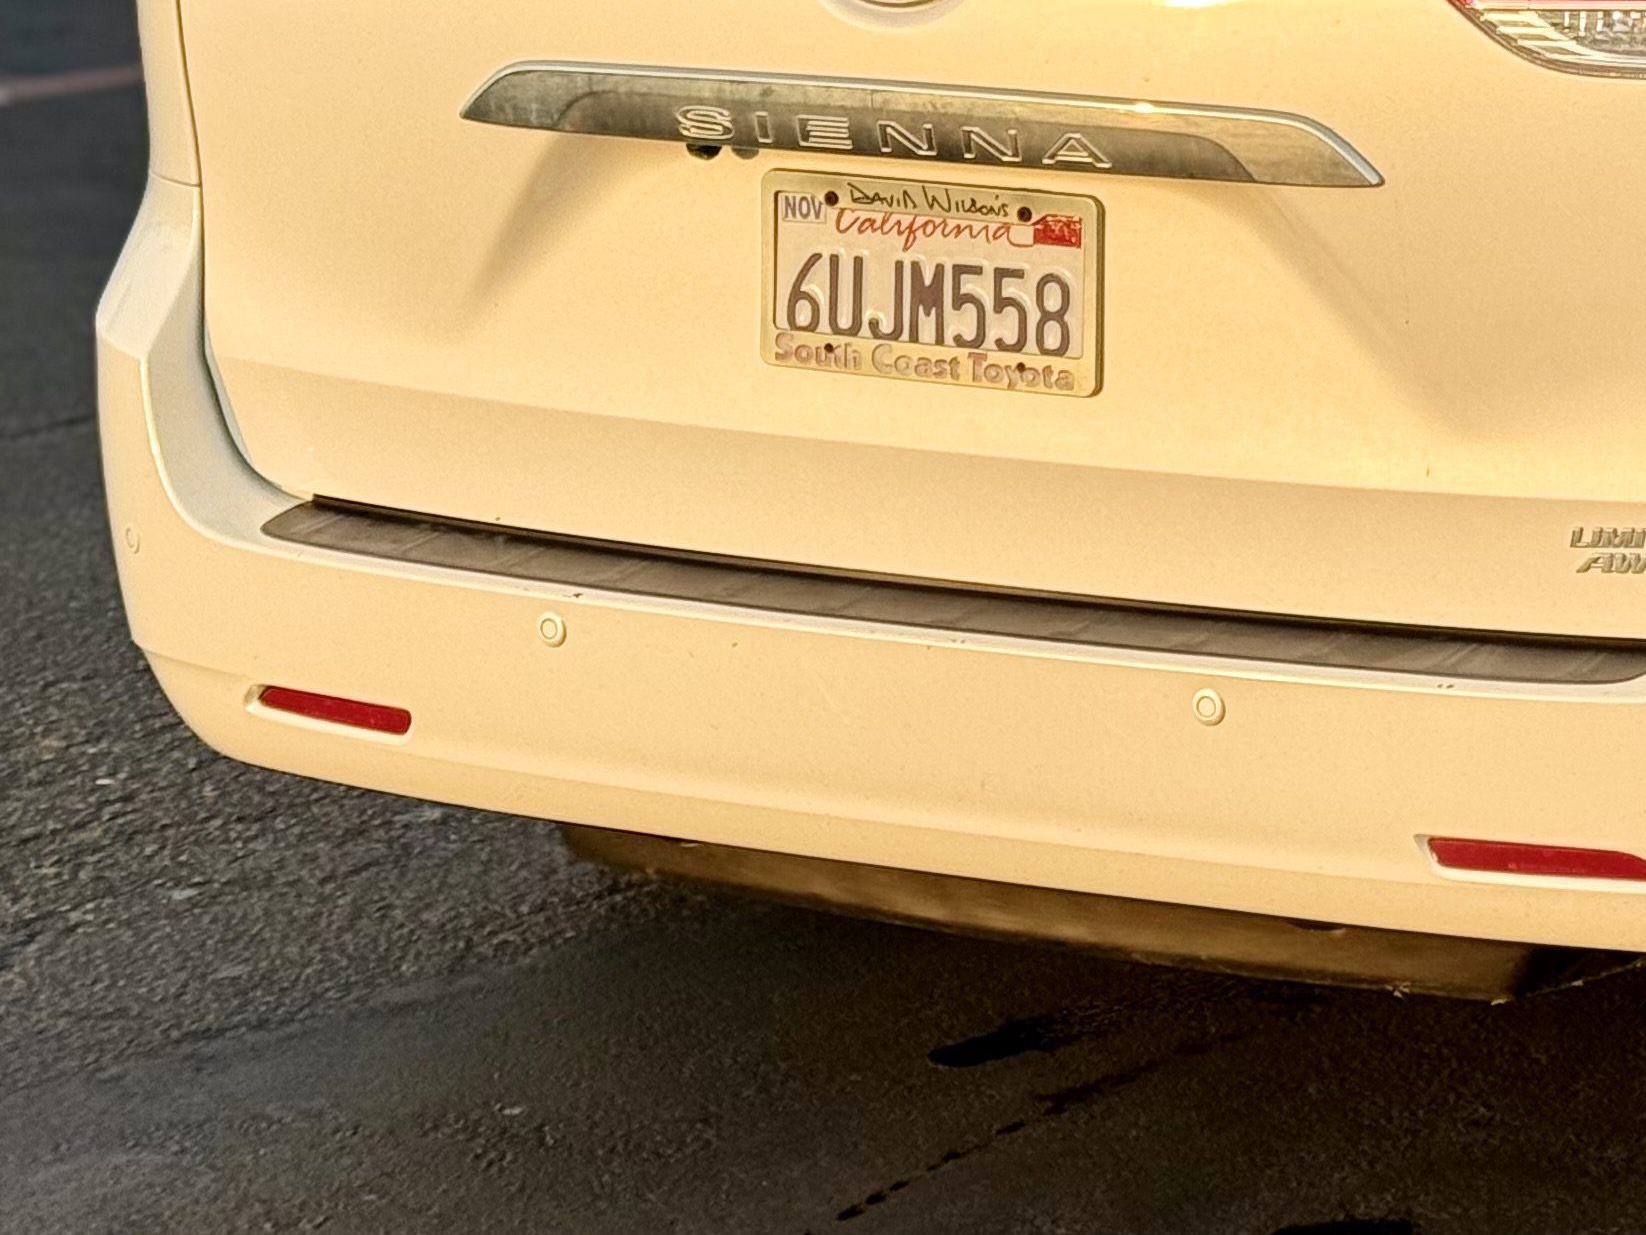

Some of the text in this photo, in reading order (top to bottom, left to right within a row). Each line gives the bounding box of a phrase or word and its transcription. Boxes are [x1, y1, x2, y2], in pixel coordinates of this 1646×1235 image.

[676, 106, 1111, 168] SIENNA
[783, 194, 824, 221] NOV
[835, 207, 1012, 252] California
[787, 253, 1070, 356] 6UJM558
[775, 332, 1075, 391] South Coast Toyota
